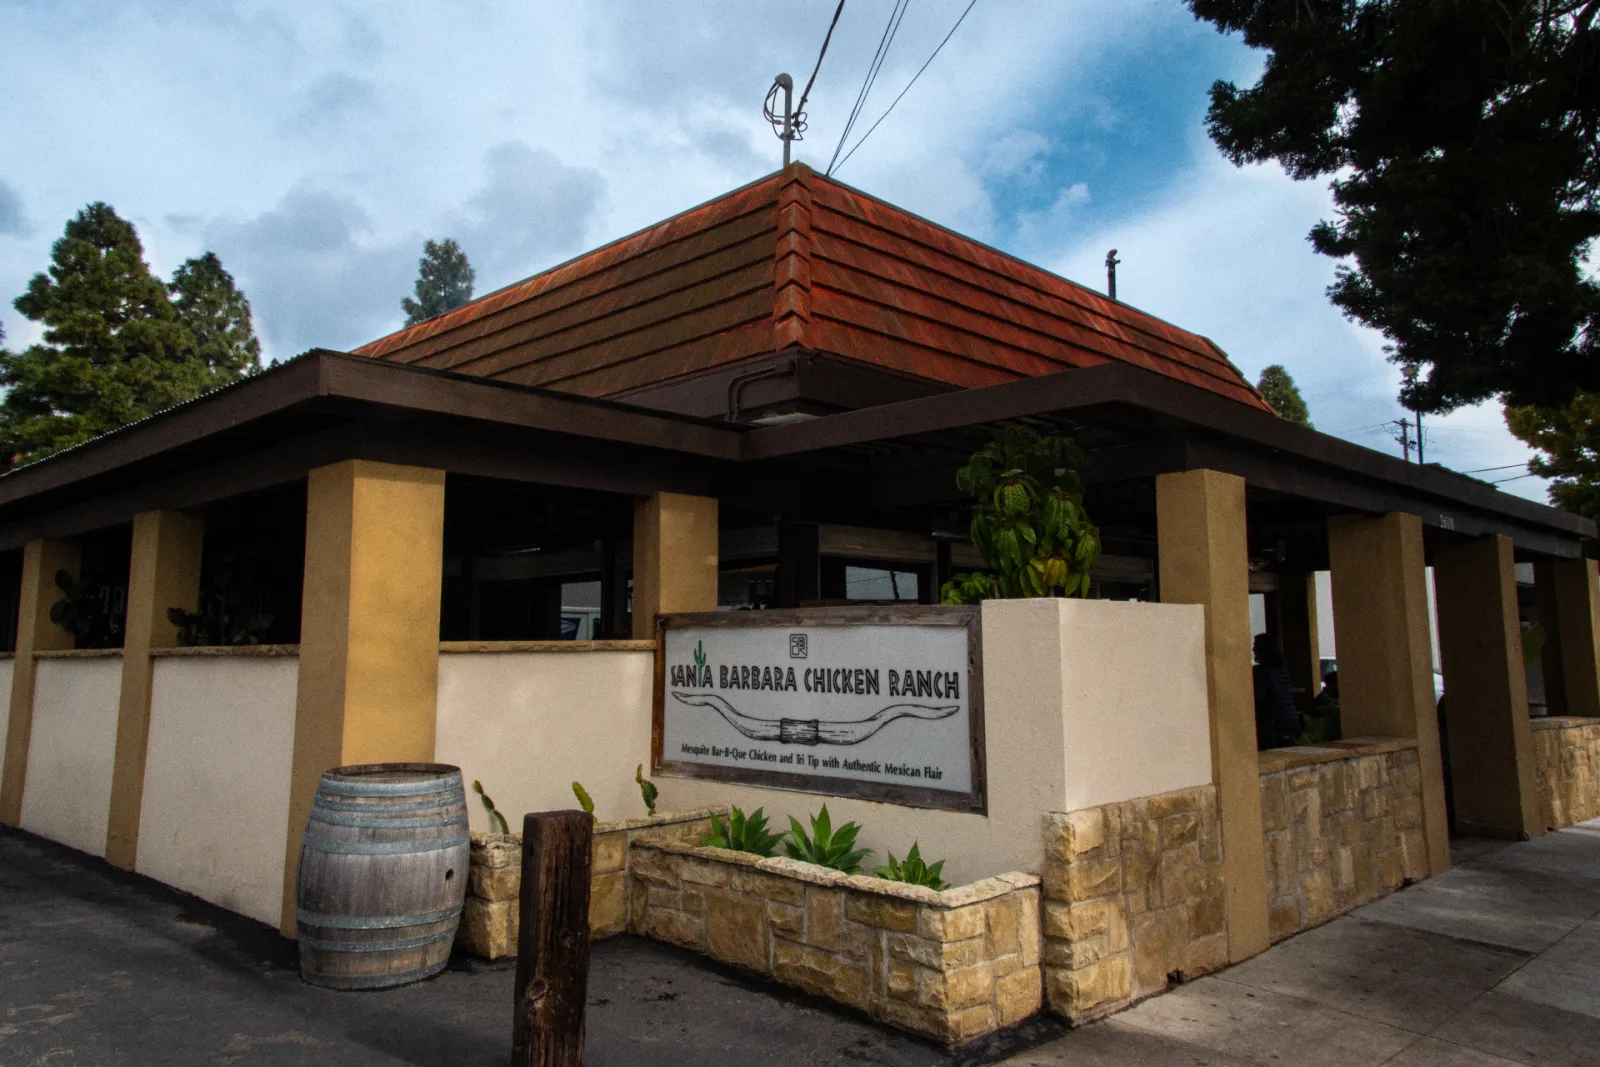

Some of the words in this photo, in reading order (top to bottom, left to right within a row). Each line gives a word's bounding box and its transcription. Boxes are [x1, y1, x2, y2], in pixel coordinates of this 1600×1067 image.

[719, 664, 798, 692] BARBARA
[804, 667, 880, 695] CHICKEN
[888, 669, 960, 700] RANCH
[681, 743, 710, 757] Mesquite
[711, 745, 747, 761] Bar-B-Que
[748, 748, 777, 762] Chicken
[779, 753, 794, 765] and
[796, 753, 805, 765] Tri
[807, 754, 820, 770] Tip
[822, 756, 840, 769] with
[842, 758, 882, 774] Authentic
[884, 763, 921, 778] Mexican
[924, 765, 943, 780] Flair
